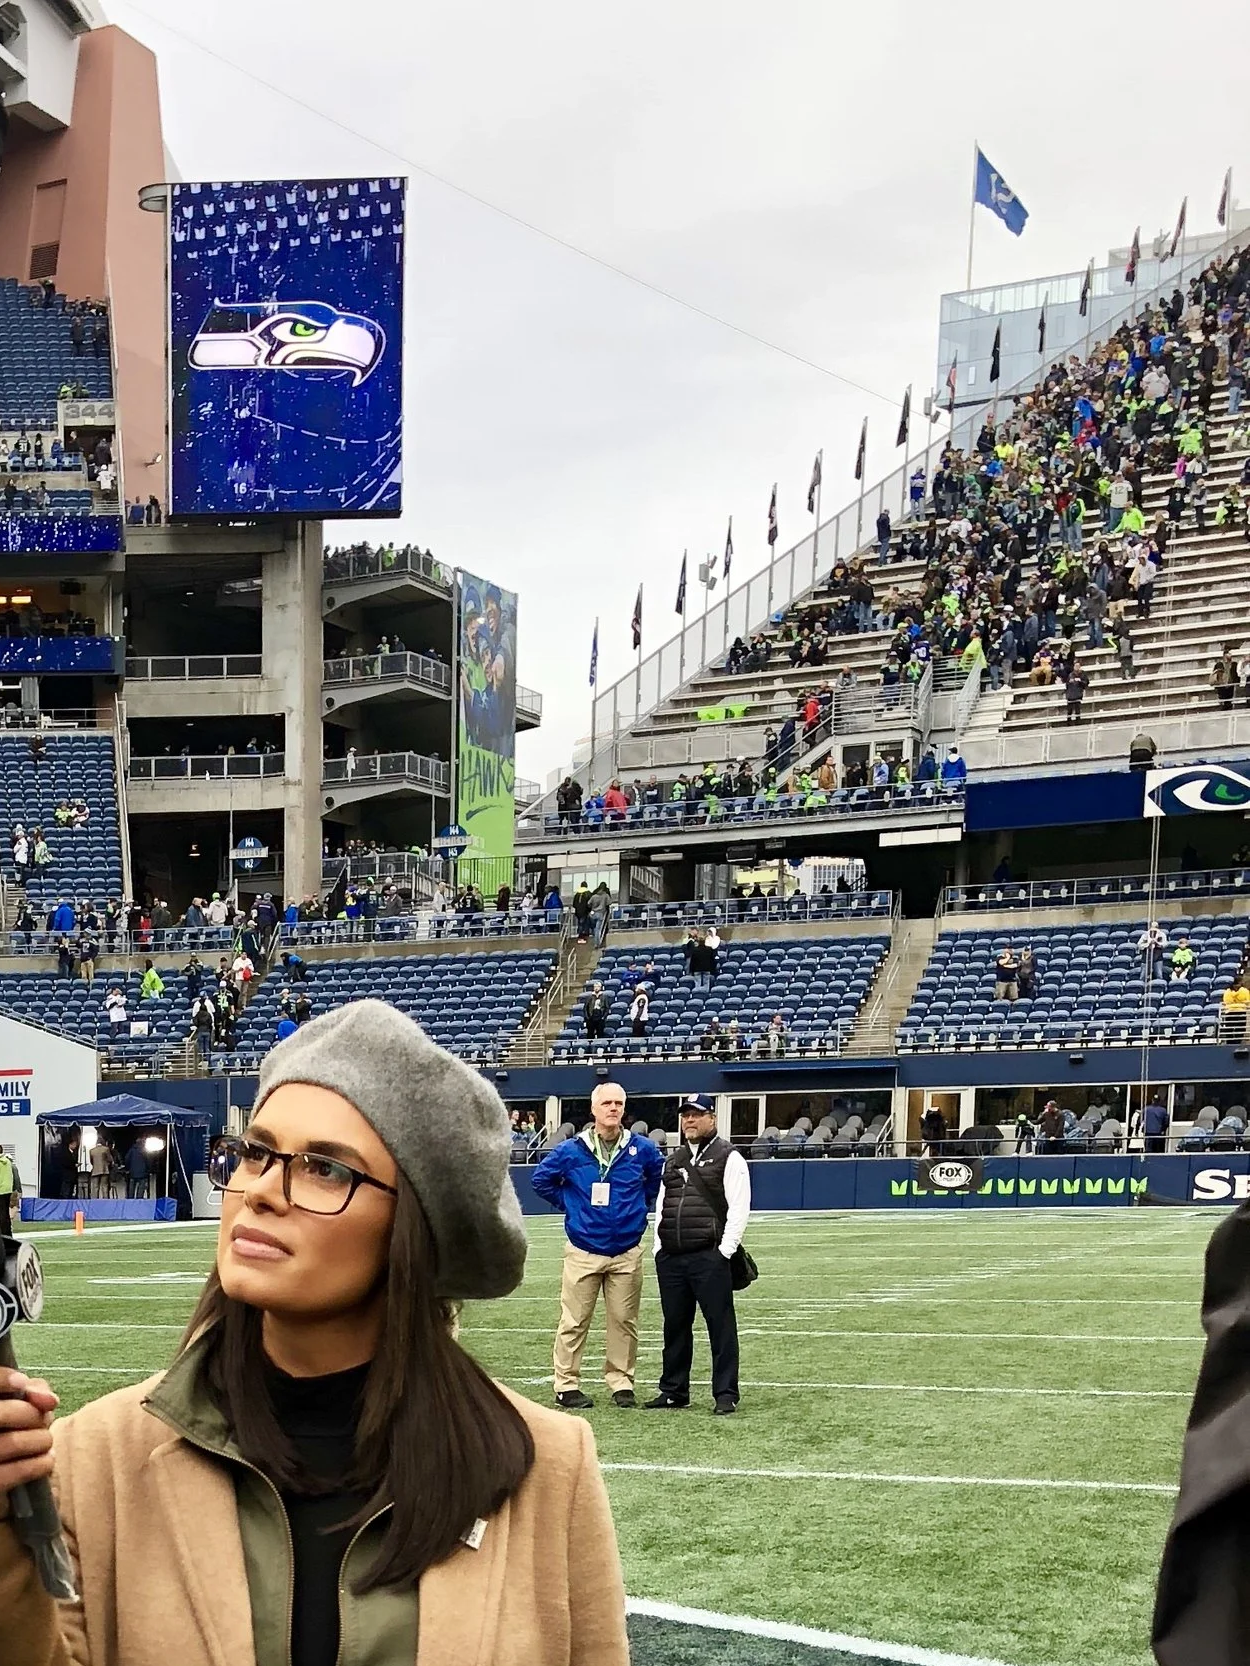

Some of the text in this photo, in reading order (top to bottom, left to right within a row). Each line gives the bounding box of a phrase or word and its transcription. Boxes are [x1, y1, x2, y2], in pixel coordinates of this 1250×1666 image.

[65, 404, 115, 418] 344
[233, 483, 247, 494] 16
[939, 1167, 962, 1177] FOX
[21, 1252, 39, 1299] FOX
